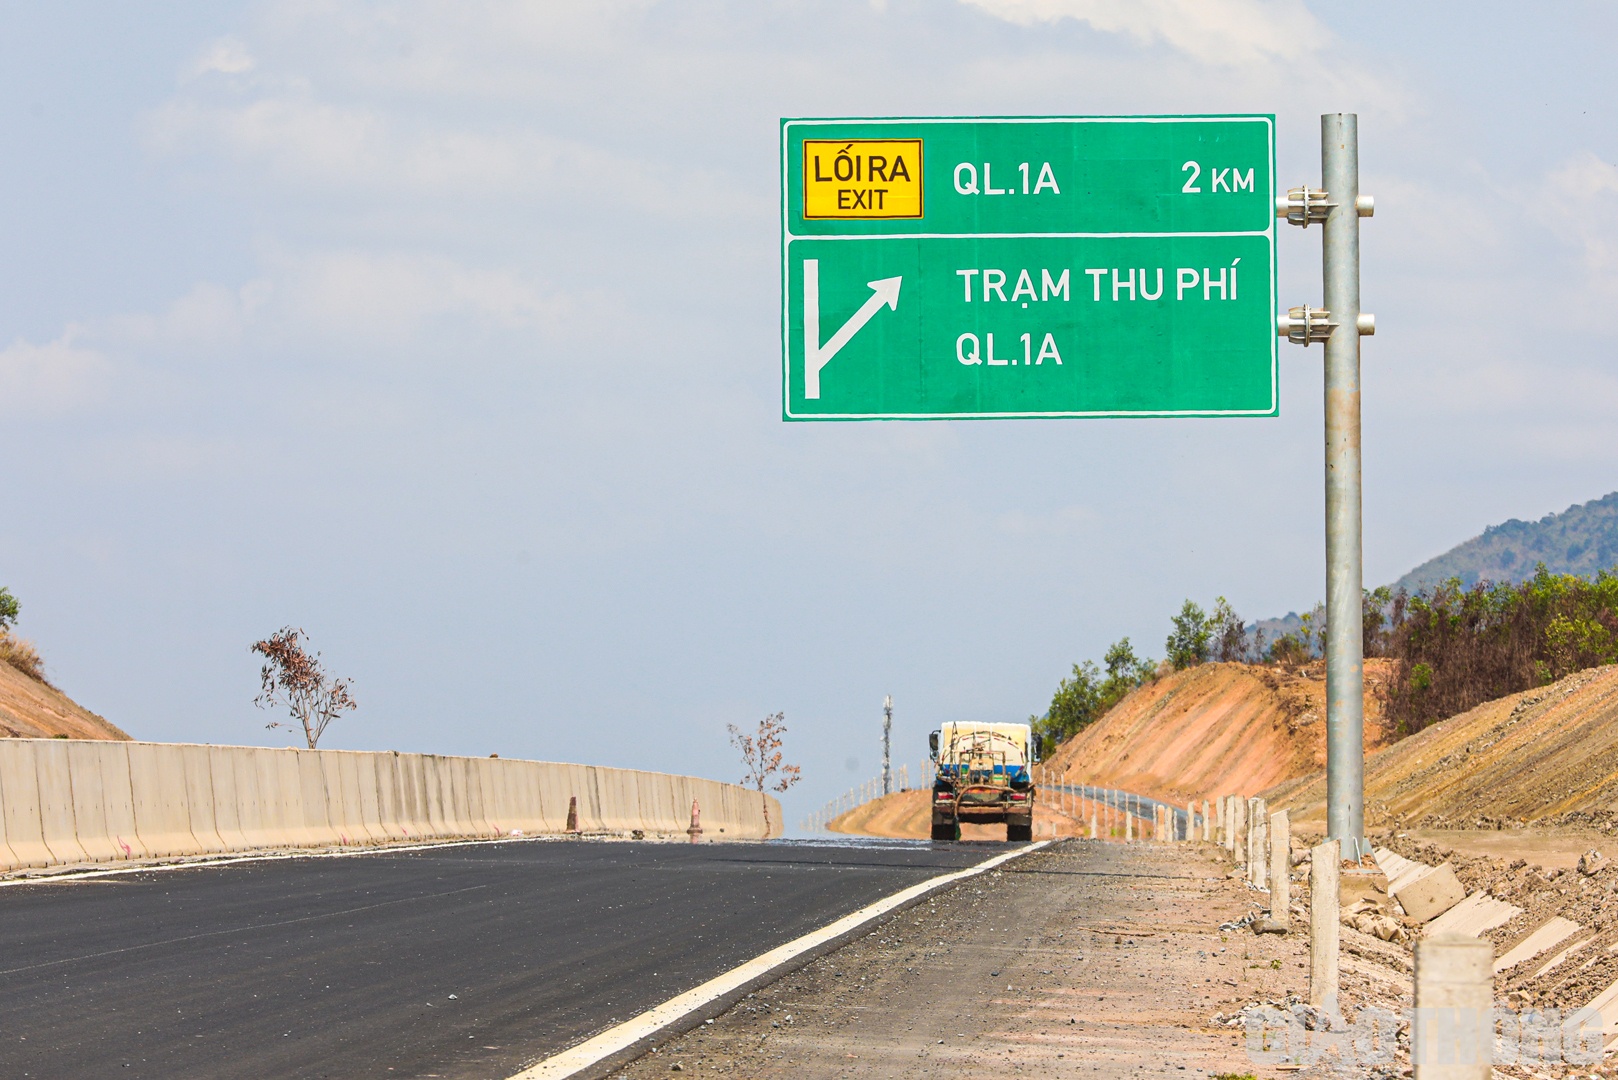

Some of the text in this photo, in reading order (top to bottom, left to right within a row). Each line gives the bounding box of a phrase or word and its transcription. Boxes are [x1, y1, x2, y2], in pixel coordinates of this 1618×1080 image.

[814, 143, 911, 182] LỐI RA
[953, 162, 1061, 195] QL.1A
[1181, 160, 1255, 194] 2 KM
[837, 189, 889, 210] EXIT
[956, 257, 1241, 309] TRẠM THU PHÍ
[956, 332, 1063, 366] QL.1A
